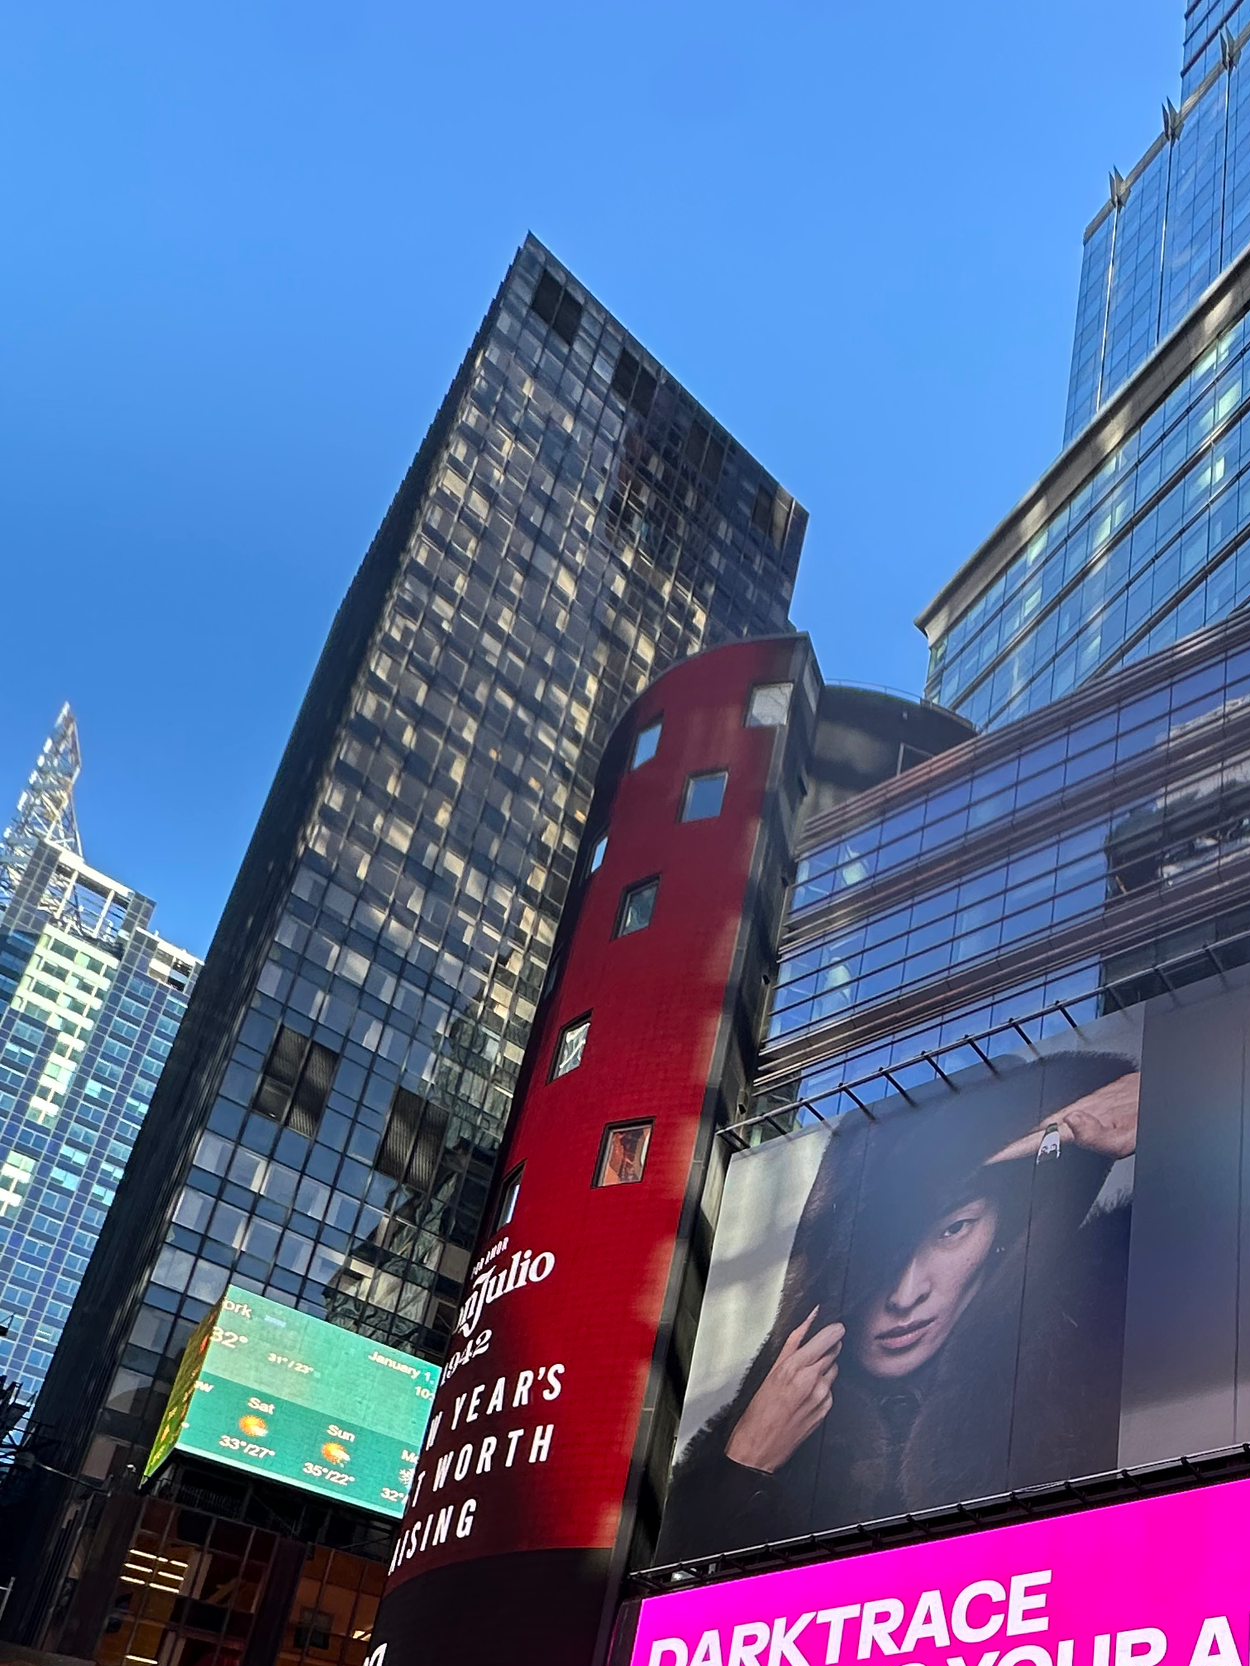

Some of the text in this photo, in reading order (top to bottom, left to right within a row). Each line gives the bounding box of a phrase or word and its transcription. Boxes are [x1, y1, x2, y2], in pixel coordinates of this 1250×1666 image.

[222, 1299, 251, 1318] ork
[368, 1351, 421, 1380] January
[247, 1397, 275, 1415] Sat
[450, 1363, 566, 1431] YEAR'S
[327, 1424, 355, 1442] Sun
[432, 1423, 554, 1492] WORTH
